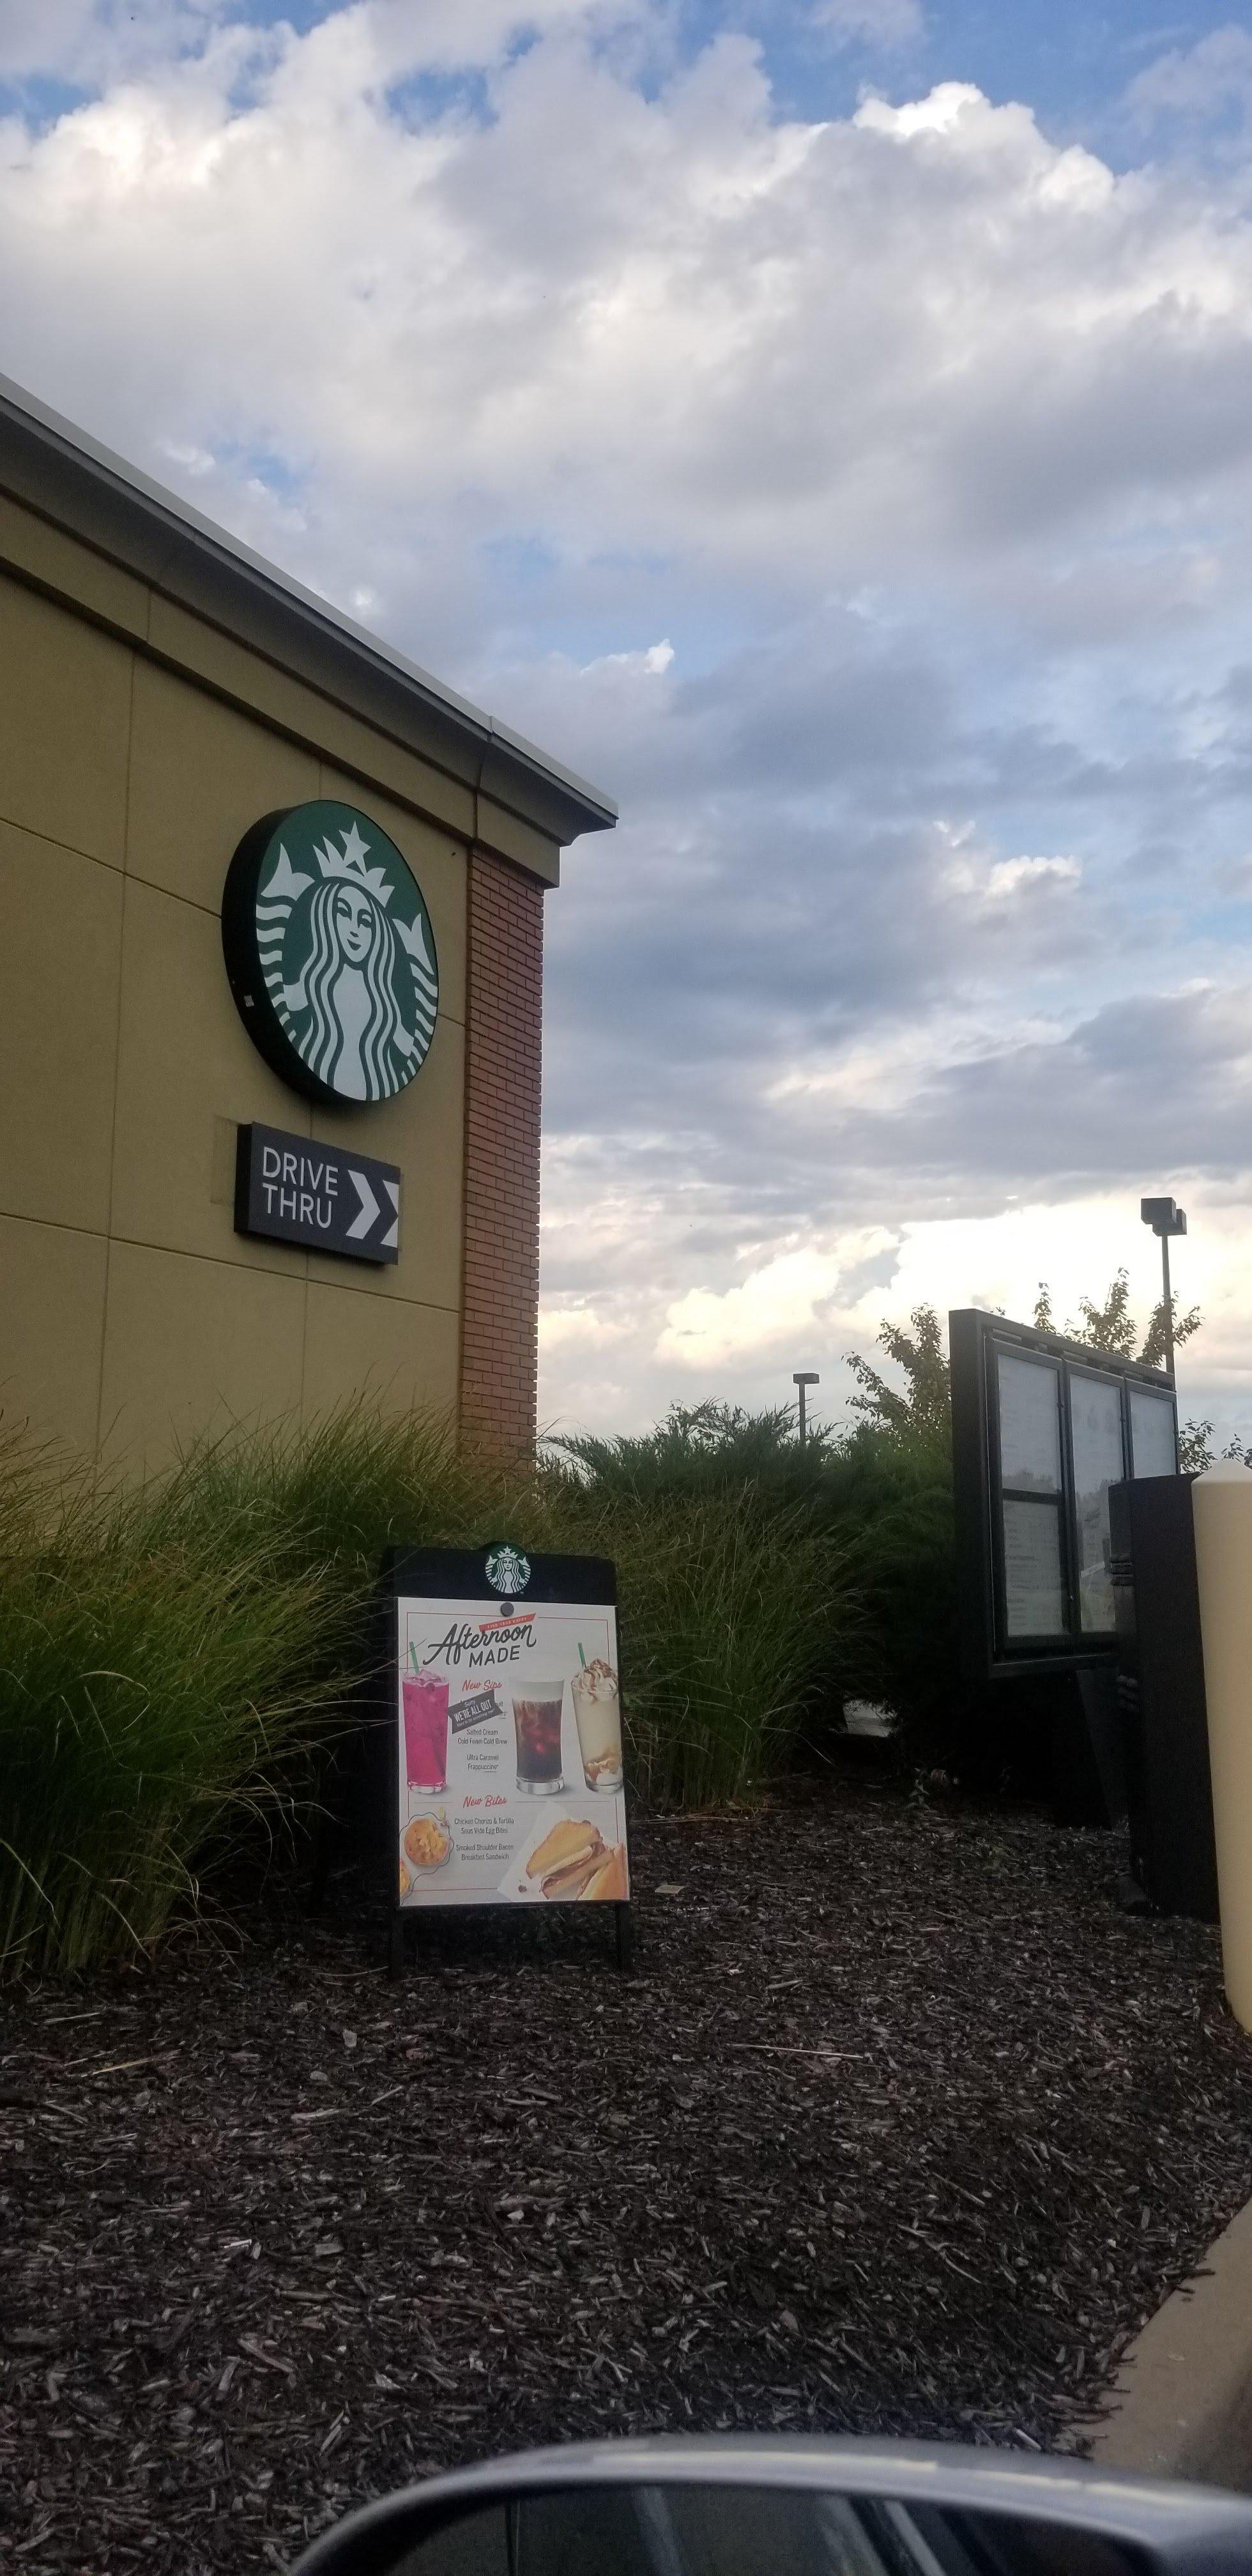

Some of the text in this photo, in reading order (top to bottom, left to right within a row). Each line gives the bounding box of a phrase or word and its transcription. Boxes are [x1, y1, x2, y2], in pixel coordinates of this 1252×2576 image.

[262, 1146, 339, 1196] DRIVE
[262, 1182, 333, 1229] THRU
[422, 1623, 537, 1666] Afternoon
[469, 1644, 521, 1668] MADE
[462, 1679, 480, 1692] New
[454, 1708, 472, 1723] WE'RE
[470, 1704, 482, 1717] ALL
[480, 1699, 492, 1712] OUT
[462, 1795, 507, 1808] New Bites
